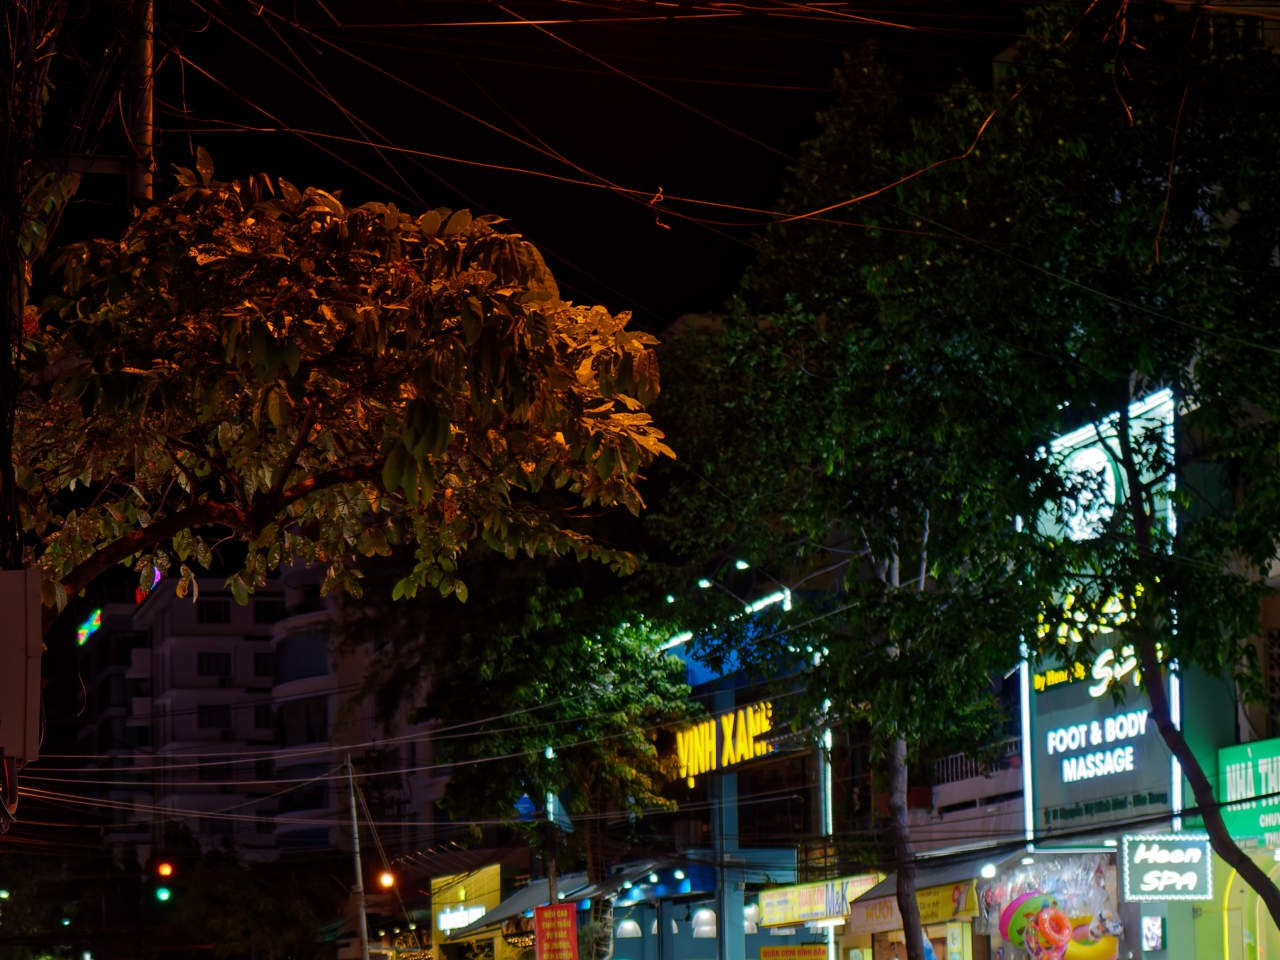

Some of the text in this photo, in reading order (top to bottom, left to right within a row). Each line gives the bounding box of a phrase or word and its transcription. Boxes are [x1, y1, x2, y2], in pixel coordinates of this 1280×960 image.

[1047, 709, 1148, 755] FOOT & BODY
[1062, 746, 1134, 783] MASSAGE
[1226, 747, 1256, 812] NHÀ
[1140, 870, 1198, 891] SPA
